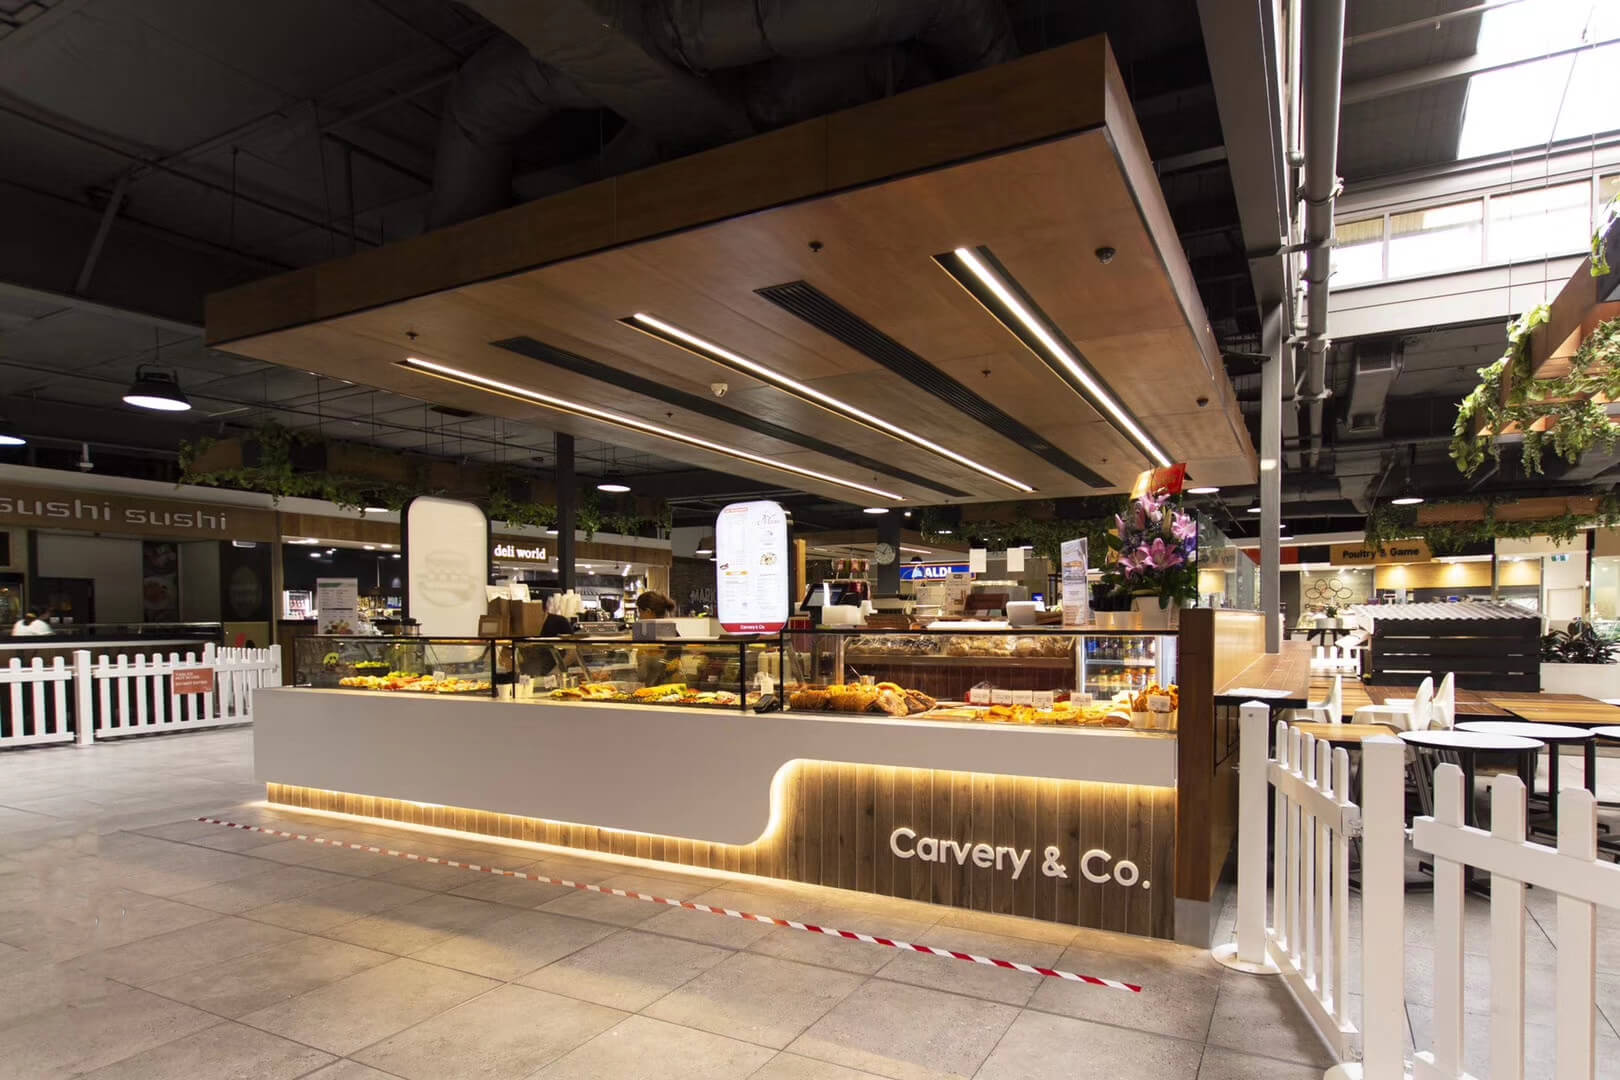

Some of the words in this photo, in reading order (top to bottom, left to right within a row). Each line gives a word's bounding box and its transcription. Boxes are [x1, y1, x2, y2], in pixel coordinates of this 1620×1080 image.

[0, 497, 110, 521] sushi
[125, 509, 227, 531] sushi
[494, 544, 515, 558] deli
[516, 547, 546, 560] world
[1343, 549, 1376, 560] Poultry
[1390, 547, 1420, 557] Game
[925, 566, 952, 578] ALDI
[889, 827, 1030, 879] Carvery
[1041, 846, 1068, 878] &
[1081, 849, 1151, 890] Co.
